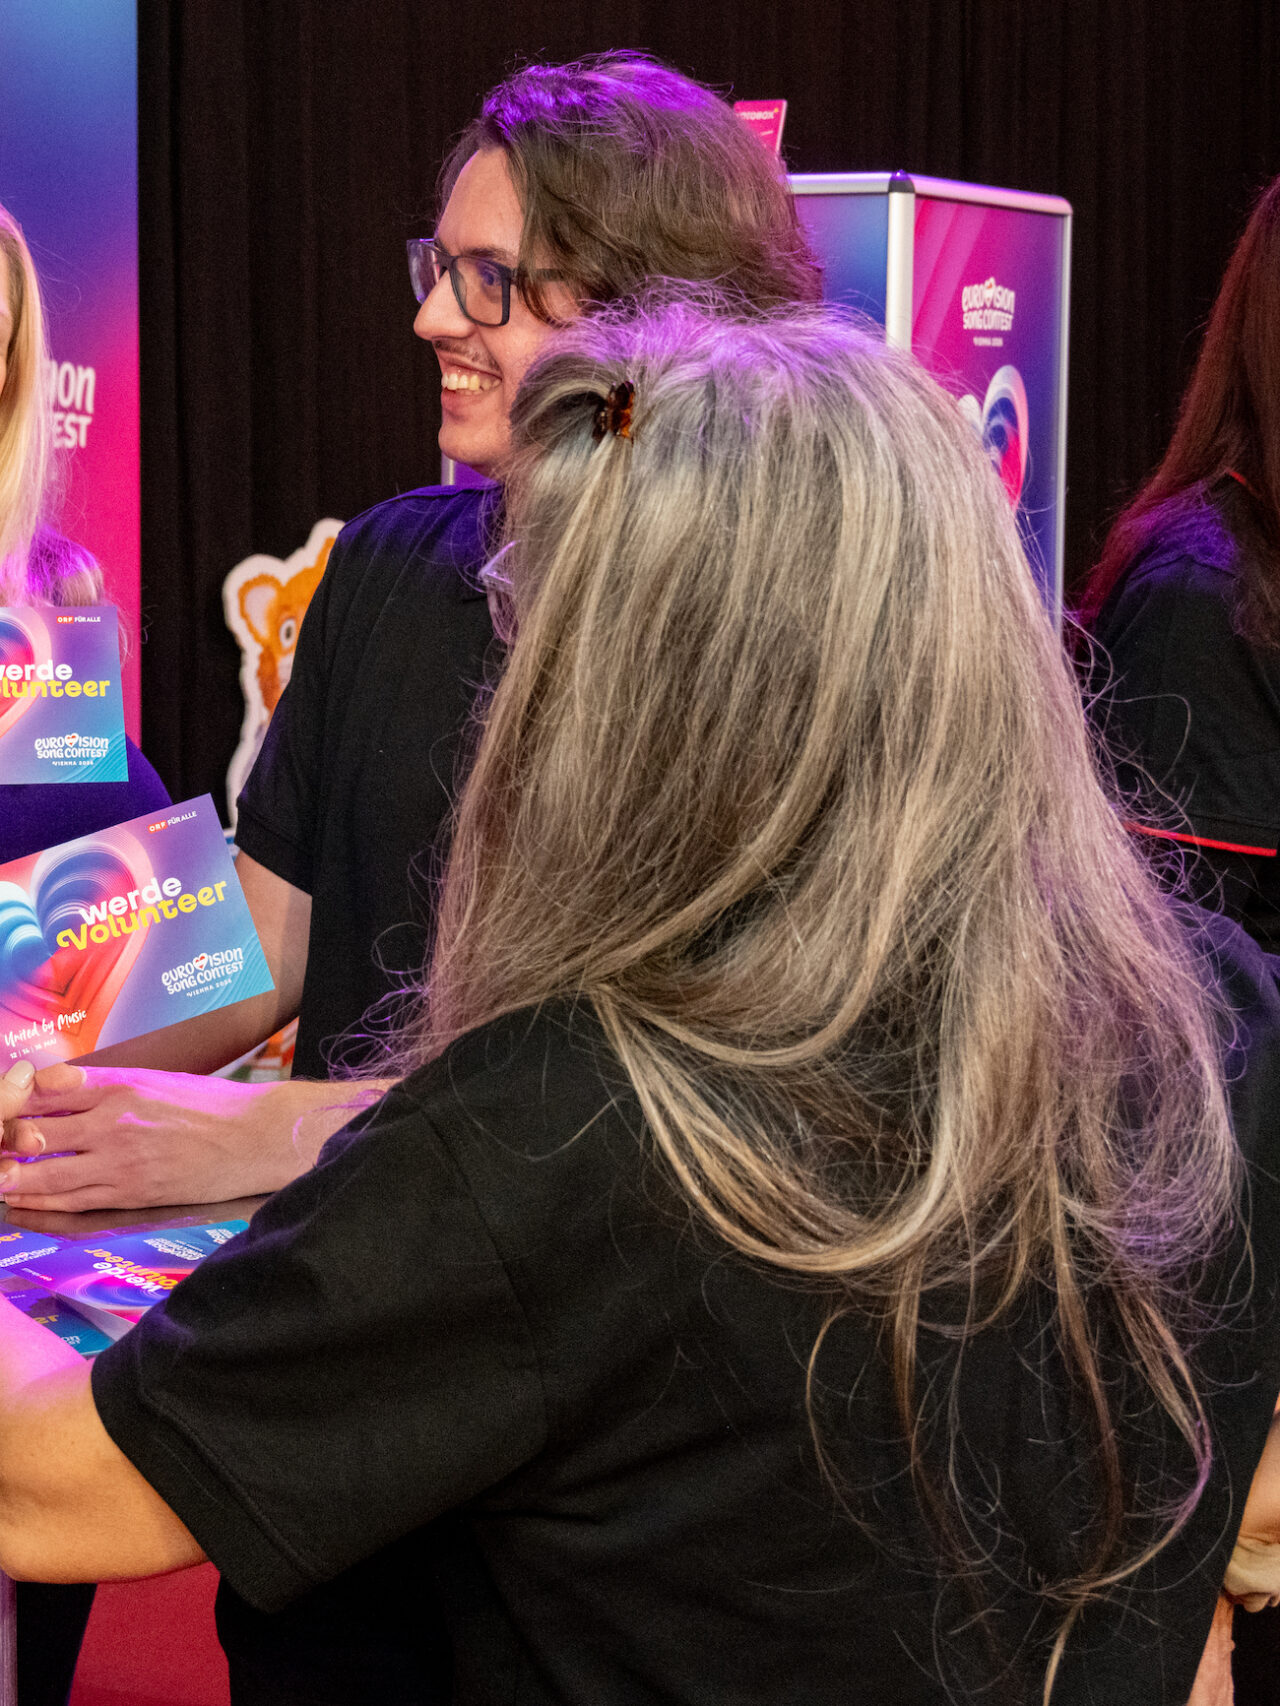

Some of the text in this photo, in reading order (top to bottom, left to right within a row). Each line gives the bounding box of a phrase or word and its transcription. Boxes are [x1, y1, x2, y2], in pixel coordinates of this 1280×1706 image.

[36, 748, 108, 759] SONG CONTEST
[56, 881, 227, 951] Volunteer
[79, 877, 182, 926] werde
[167, 961, 244, 995] SONG CONTEST
[4, 1009, 87, 1047] United by Music
[83, 1249, 178, 1289] olunteer
